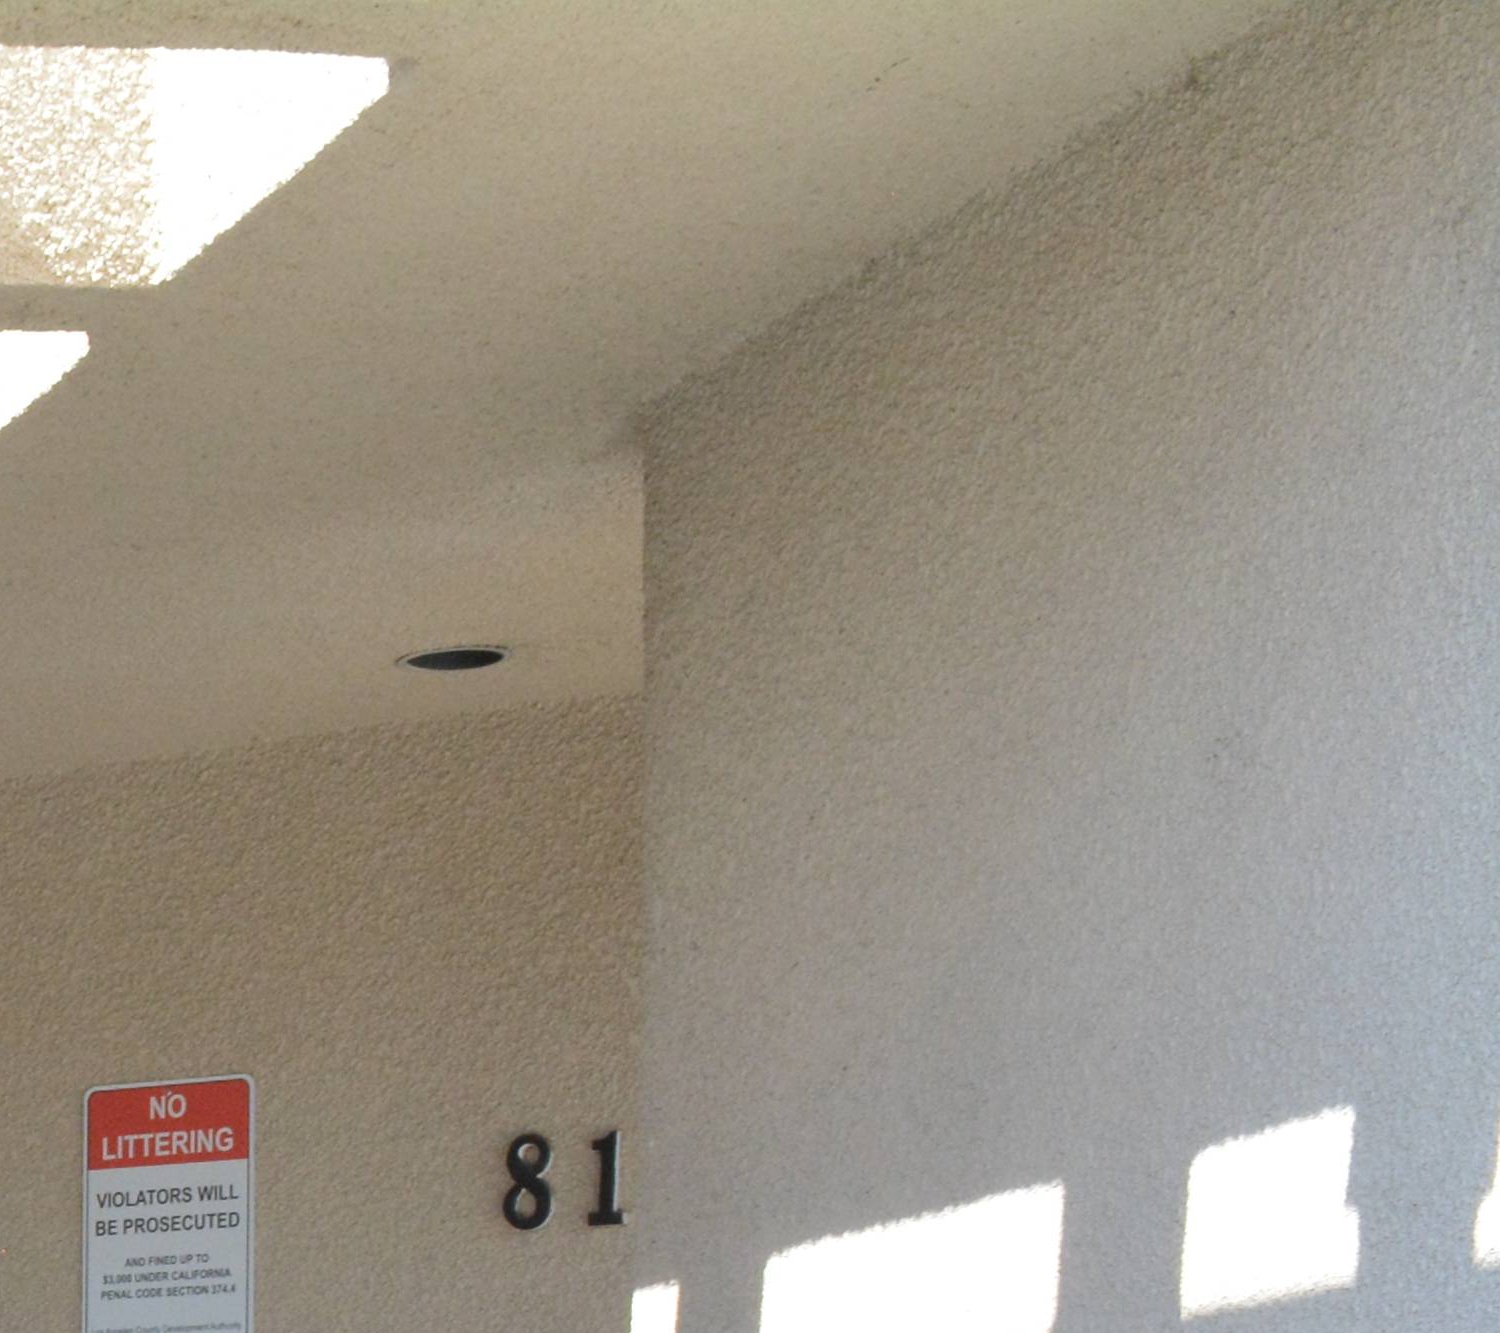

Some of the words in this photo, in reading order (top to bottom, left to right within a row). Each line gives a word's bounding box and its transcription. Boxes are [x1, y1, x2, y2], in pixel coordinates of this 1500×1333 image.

[150, 1093, 187, 1119] NO
[101, 1127, 234, 1160] LITTERING
[502, 1132, 628, 1231] 81
[97, 1187, 192, 1208] VIOLATORS
[198, 1185, 238, 1201] WILL
[95, 1220, 117, 1236] BE
[123, 1212, 240, 1234] PROSECUTED
[125, 1257, 146, 1267] AND
[148, 1255, 178, 1266] FINED
[179, 1255, 193, 1264] UP
[196, 1253, 210, 1263] TO
[134, 1271, 169, 1282] UNDER
[171, 1268, 231, 1281] CALIFORNIA
[101, 1288, 133, 1301] PENAL
[135, 1287, 163, 1299] CODE
[165, 1285, 209, 1297] SECTION
